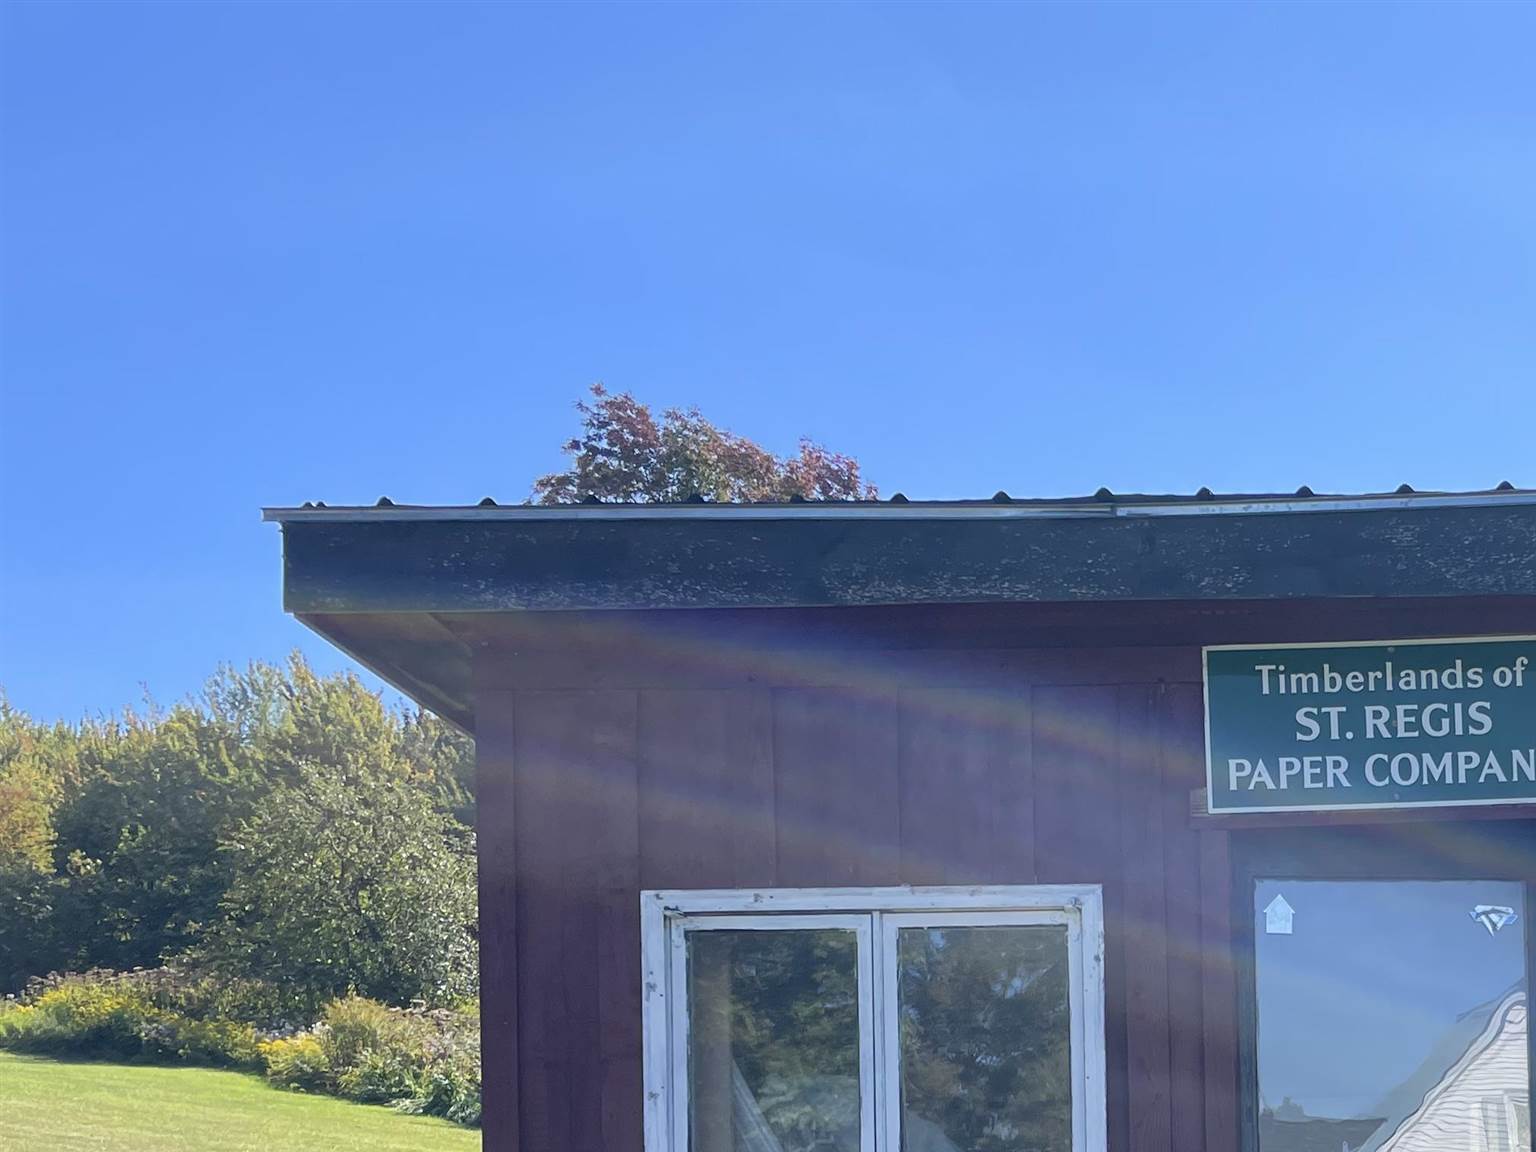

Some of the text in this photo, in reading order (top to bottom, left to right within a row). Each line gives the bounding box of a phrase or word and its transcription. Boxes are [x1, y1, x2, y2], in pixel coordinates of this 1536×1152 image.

[1255, 657, 1528, 695] Timberlands of
[1295, 701, 1493, 742] ST. REGIS
[1228, 755, 1352, 791] PAPER
